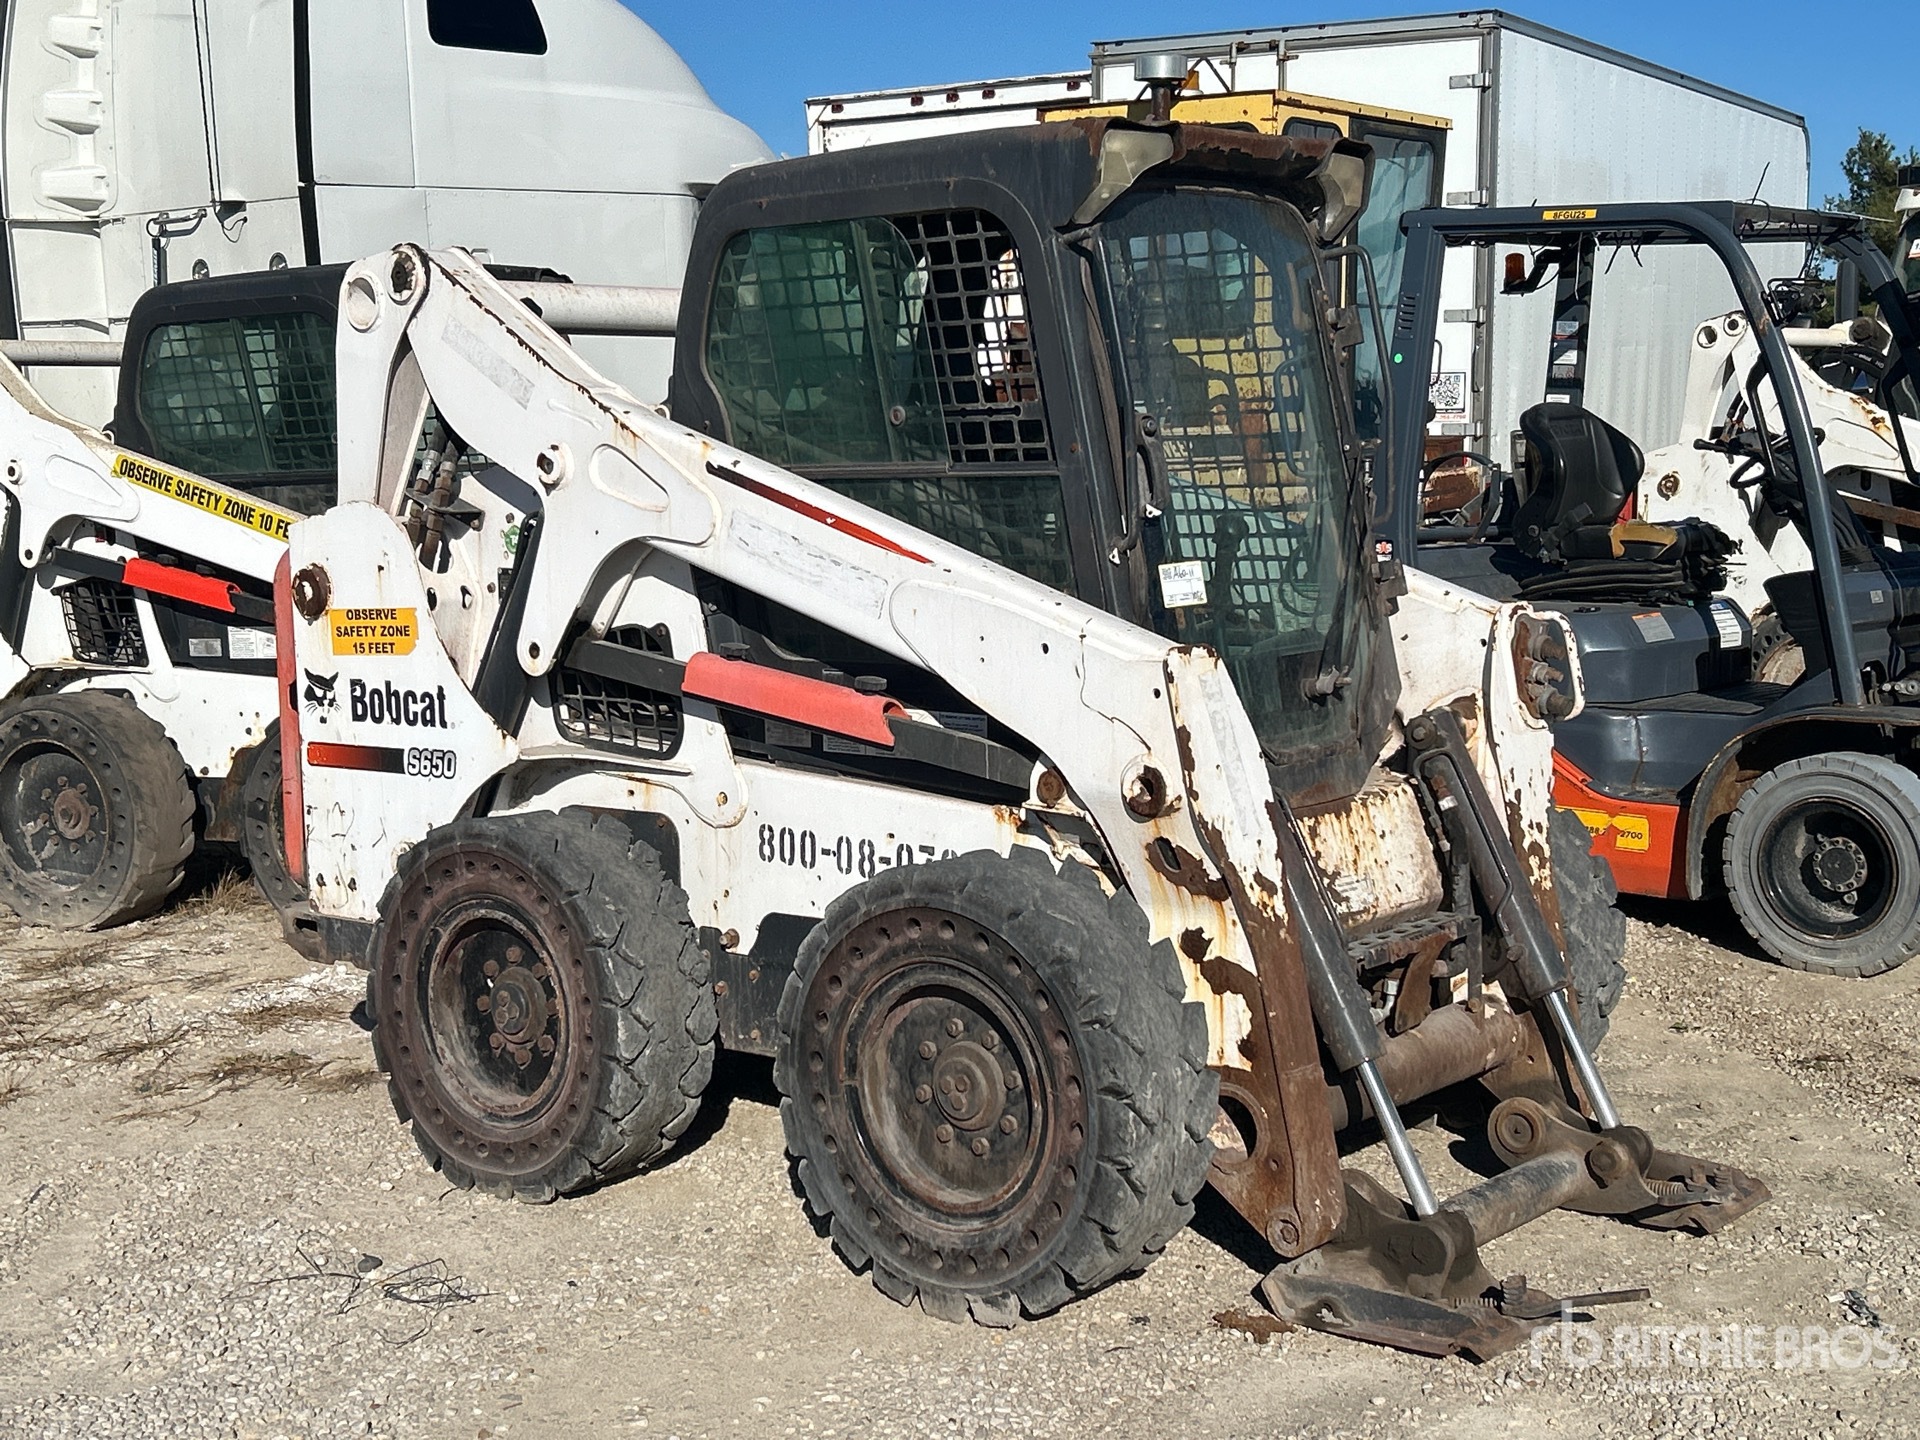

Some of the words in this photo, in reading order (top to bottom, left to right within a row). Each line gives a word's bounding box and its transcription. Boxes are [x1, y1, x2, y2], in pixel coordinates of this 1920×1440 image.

[1552, 210, 1587, 219] 8FGU25
[119, 458, 173, 493] OBSERVE
[174, 479, 222, 511] SAFETY
[223, 498, 256, 525] ZONE
[259, 512, 273, 532] 10
[346, 608, 397, 620] OBSERVE
[336, 625, 377, 638] SAFETY
[380, 625, 410, 637] ZONE
[353, 642, 366, 654] 15
[368, 642, 395, 654] FEET
[350, 678, 448, 729] Bobcat
[407, 747, 457, 779] S650
[758, 823, 958, 880] 800-08-07
